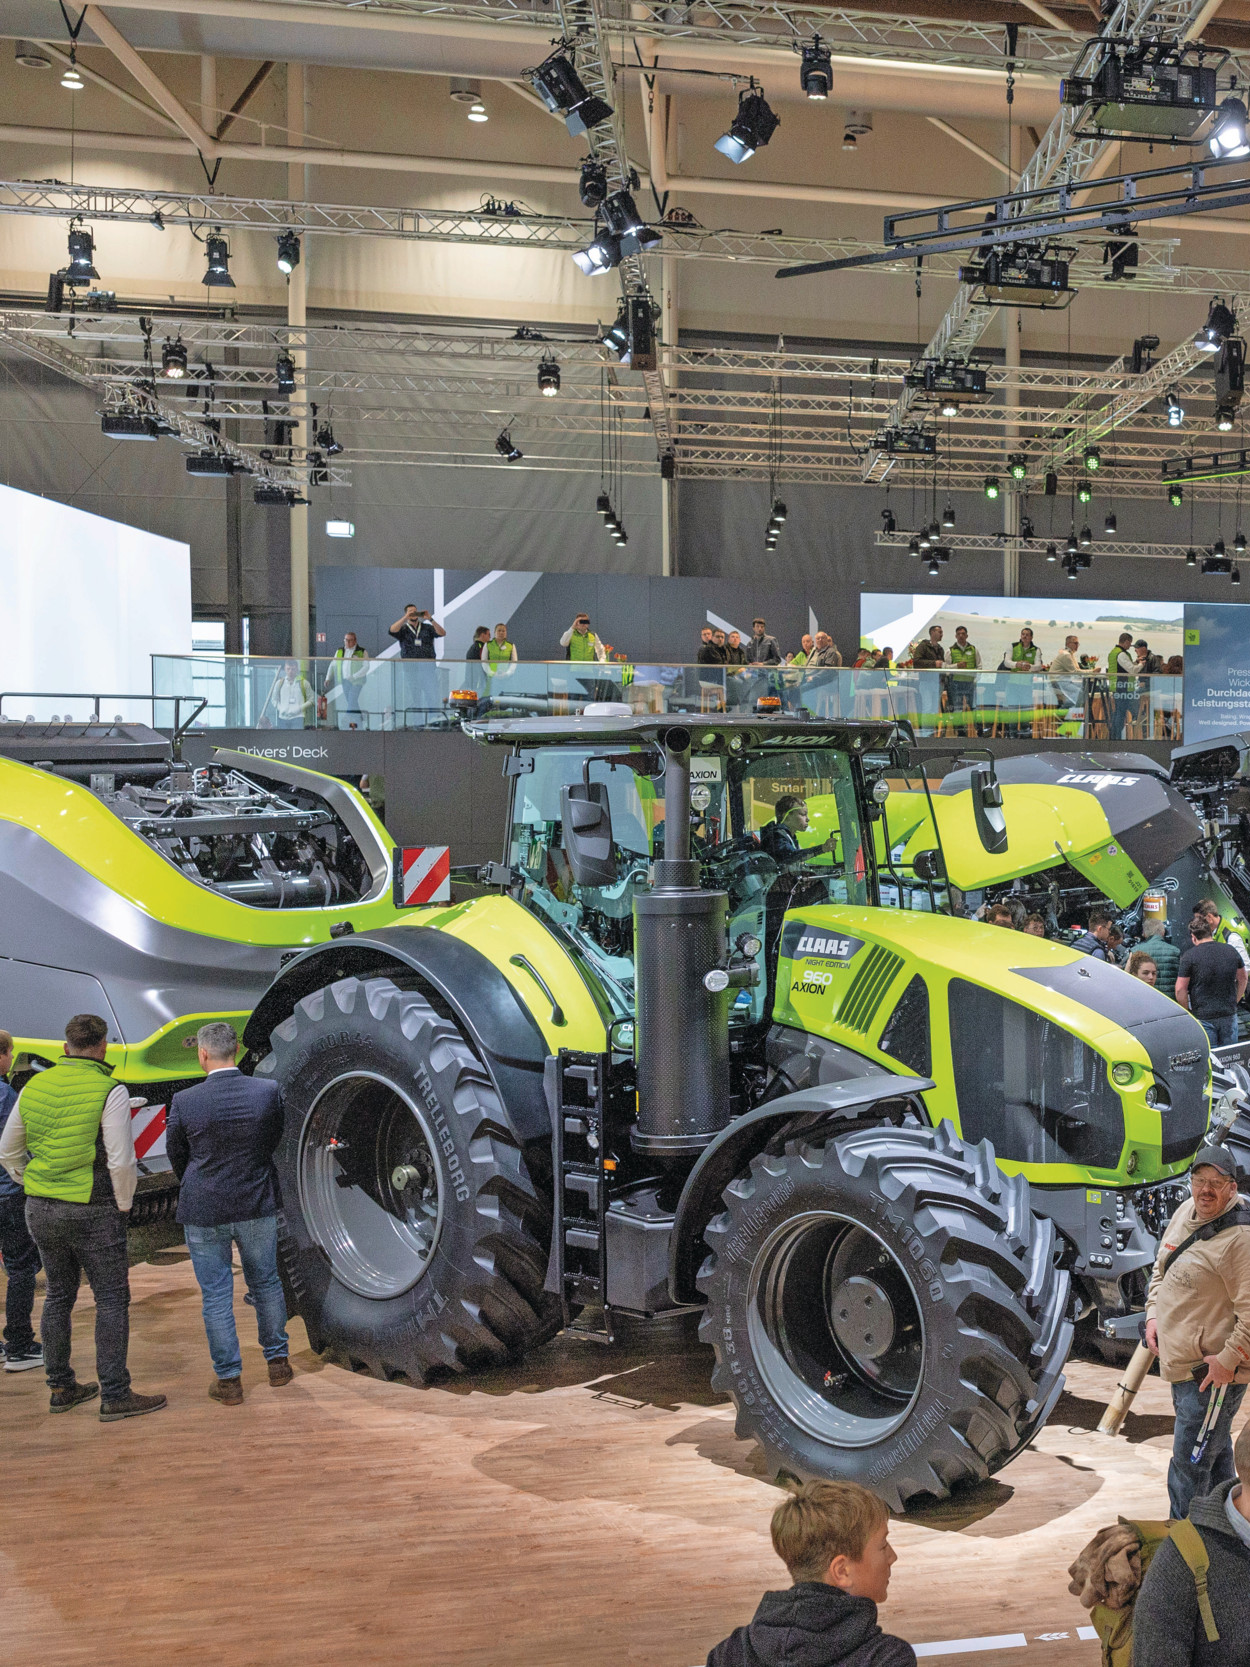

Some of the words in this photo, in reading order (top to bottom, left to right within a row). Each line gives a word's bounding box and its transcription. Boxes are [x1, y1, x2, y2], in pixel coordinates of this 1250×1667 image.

[760, 735, 837, 745] AXION
[292, 746, 329, 758] Deck
[689, 770, 718, 779] AXION
[796, 936, 851, 956] CLAAS
[805, 958, 825, 968] NIGHT
[825, 960, 852, 970] EDITION
[803, 970, 834, 986] 960
[791, 981, 827, 996] AXION
[413, 1060, 471, 1203] TRELLEBORG
[722, 1175, 796, 1264] TRELLEBORG
[868, 1190, 944, 1302] TM1060
